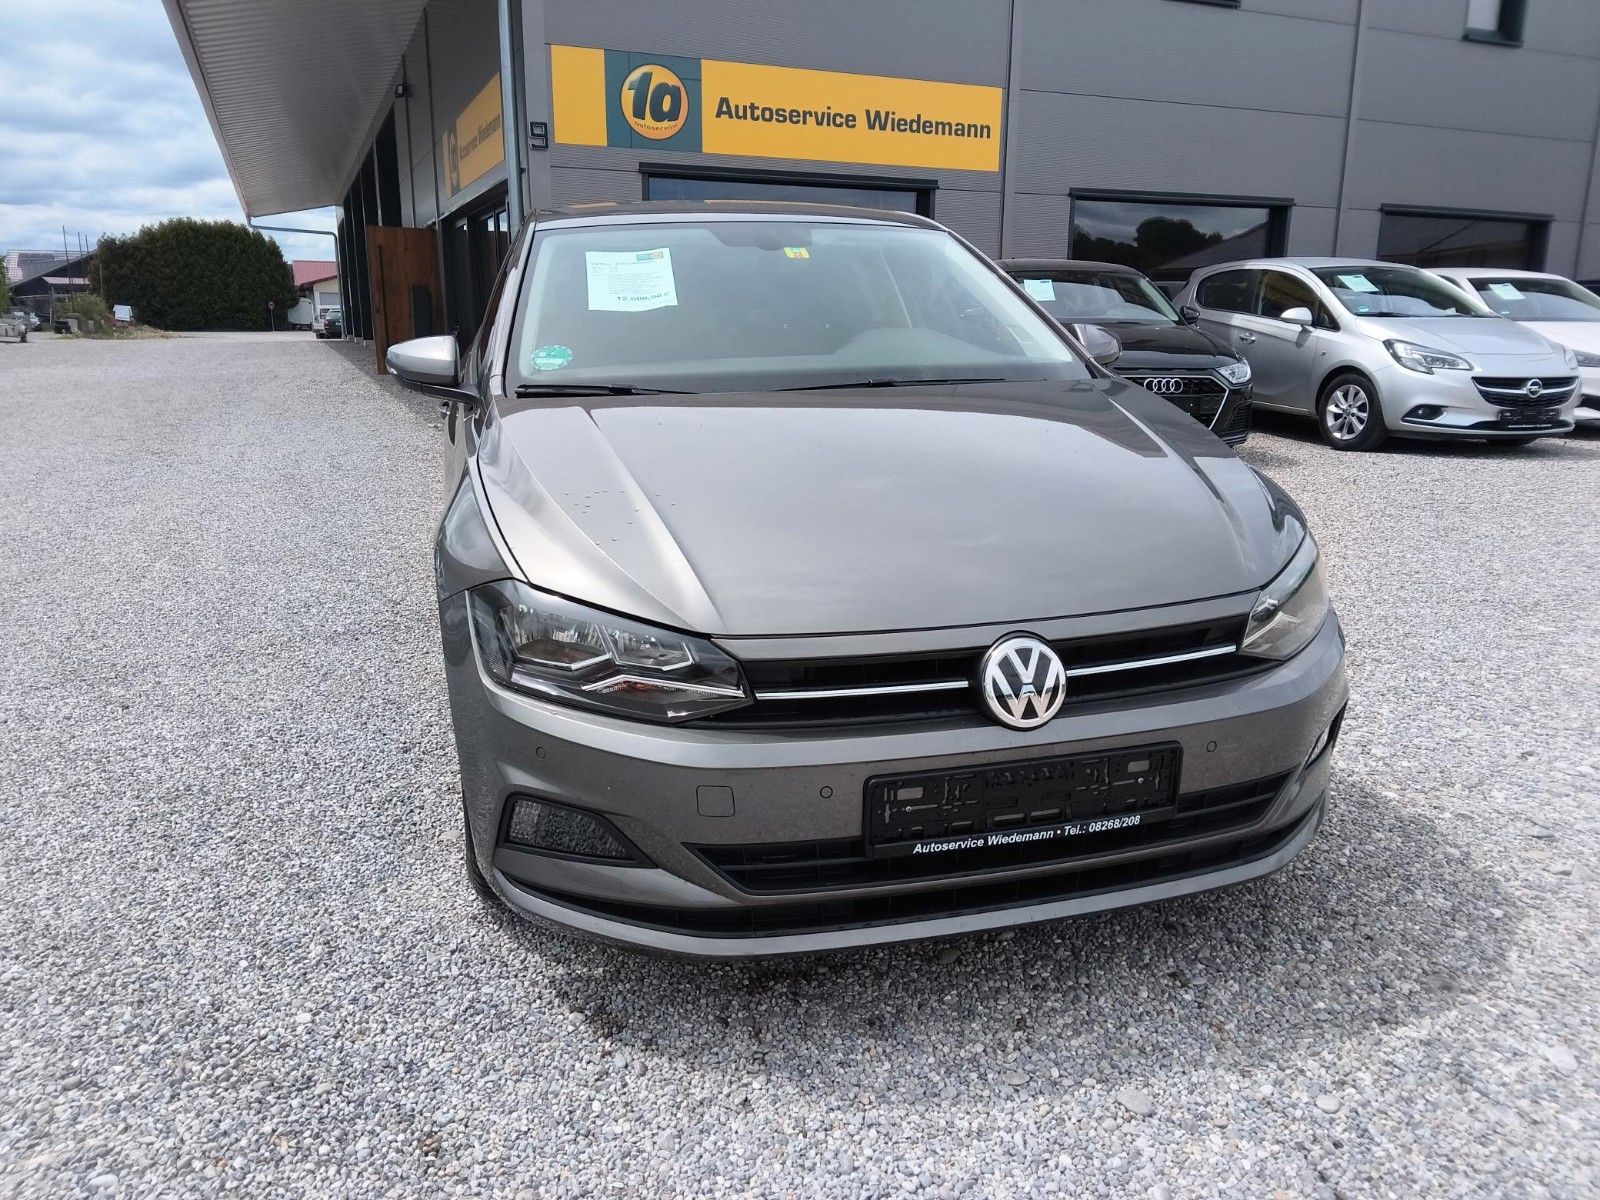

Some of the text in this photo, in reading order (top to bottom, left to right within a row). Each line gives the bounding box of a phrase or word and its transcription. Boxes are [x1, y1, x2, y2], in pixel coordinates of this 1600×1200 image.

[627, 71, 682, 122] 1a
[530, 121, 549, 149] 9
[715, 96, 991, 139] Autoservice Wiedemann
[912, 815, 1141, 855] Autoservice Wiedemann Tel.: 08268/208
